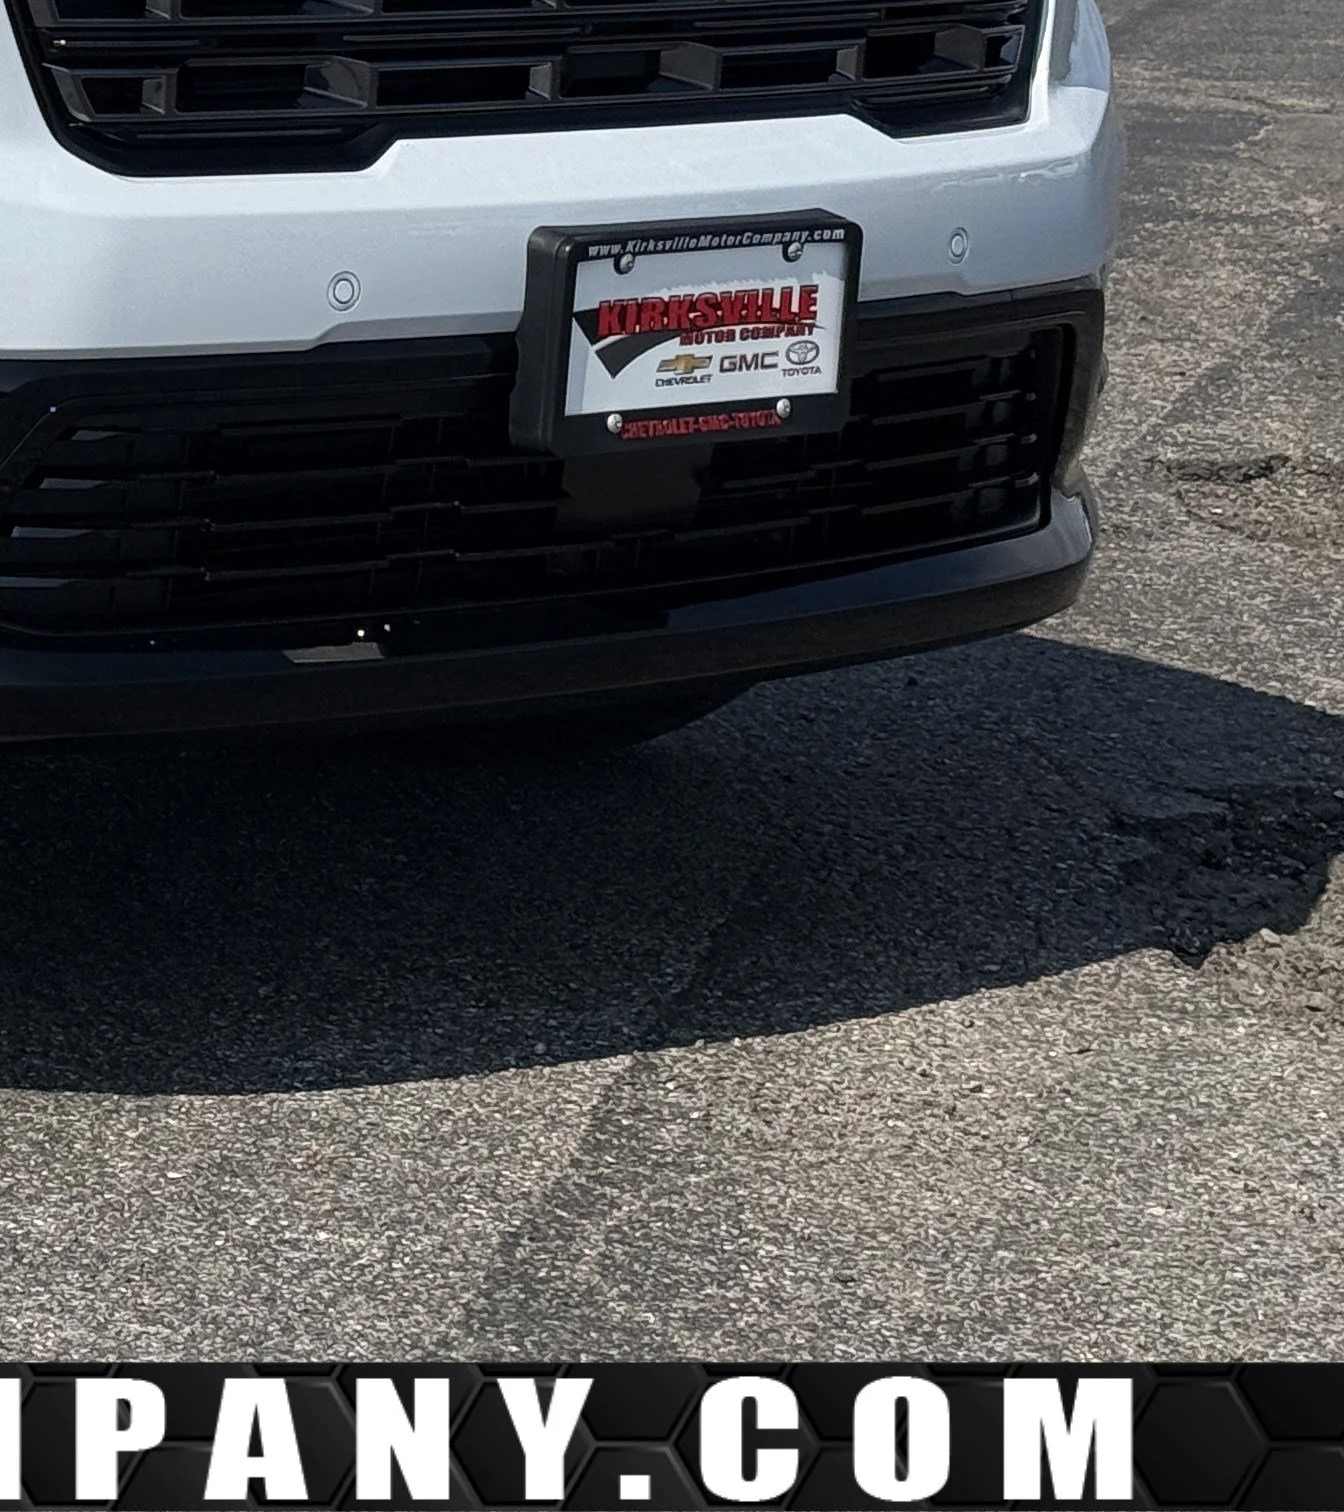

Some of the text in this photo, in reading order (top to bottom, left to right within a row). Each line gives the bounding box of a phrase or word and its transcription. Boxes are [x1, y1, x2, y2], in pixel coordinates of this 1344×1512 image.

[588, 227, 846, 258] www.KirksvilleMotorCompany.com
[597, 285, 819, 339] KIRKSVILLE
[679, 322, 816, 346] MOTOR COMPANY
[719, 350, 780, 374] GMC
[781, 366, 822, 377] TOYOTA
[654, 374, 713, 388] CHEVROLET
